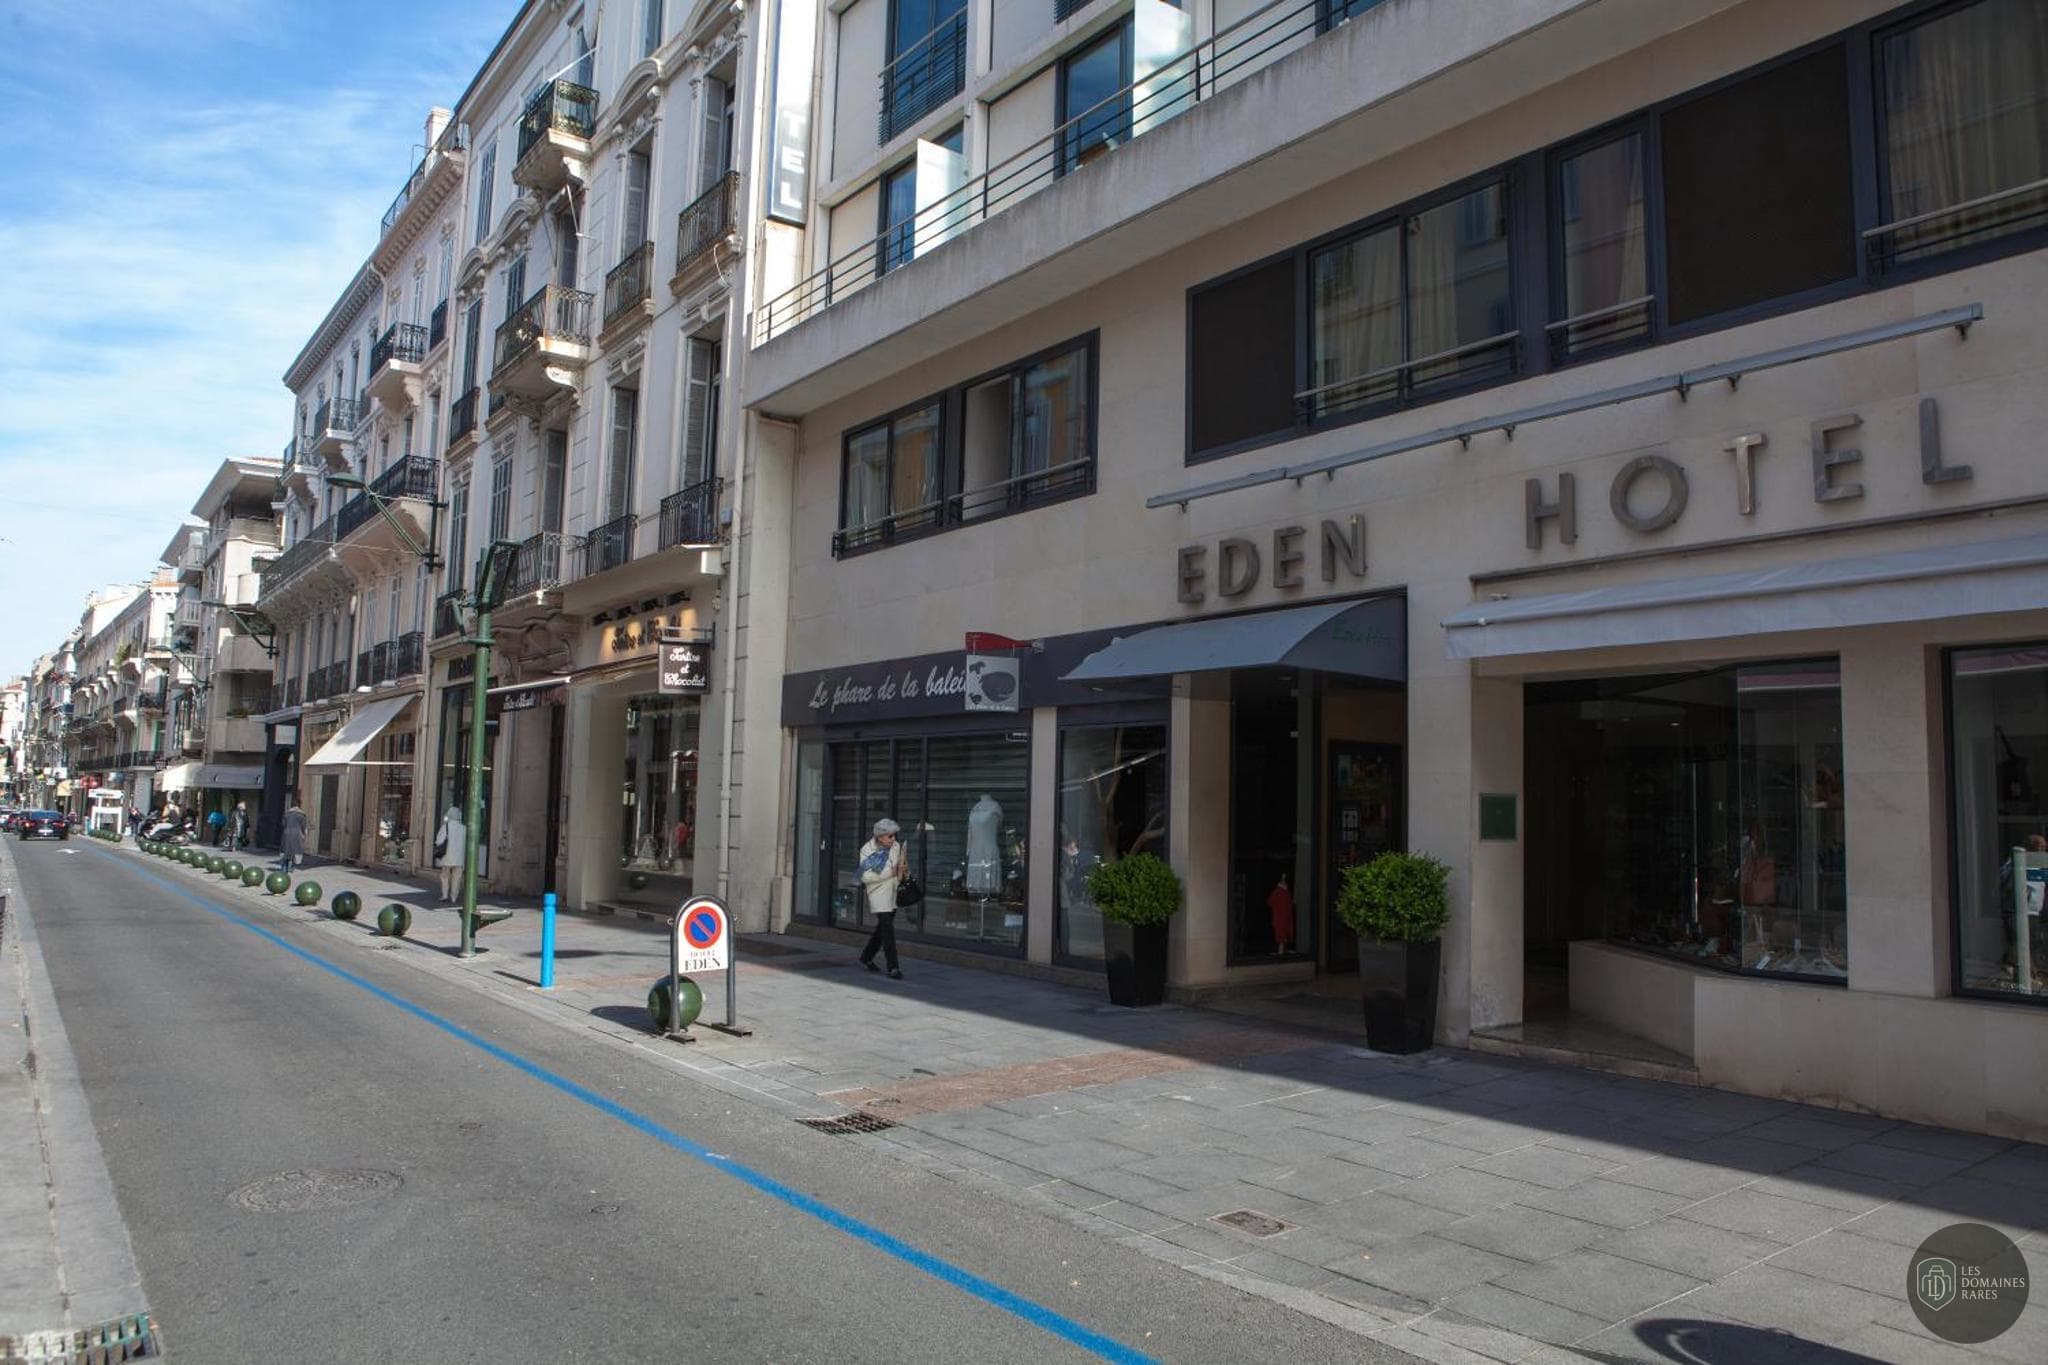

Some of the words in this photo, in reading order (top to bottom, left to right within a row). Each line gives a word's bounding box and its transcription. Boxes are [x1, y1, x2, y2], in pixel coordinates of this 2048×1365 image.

[1178, 513, 1368, 604] EDEN
[1524, 397, 1974, 549] HOTEL
[808, 681, 828, 709] Le
[831, 676, 873, 714] phare
[877, 675, 897, 701] de
[901, 671, 920, 698] la
